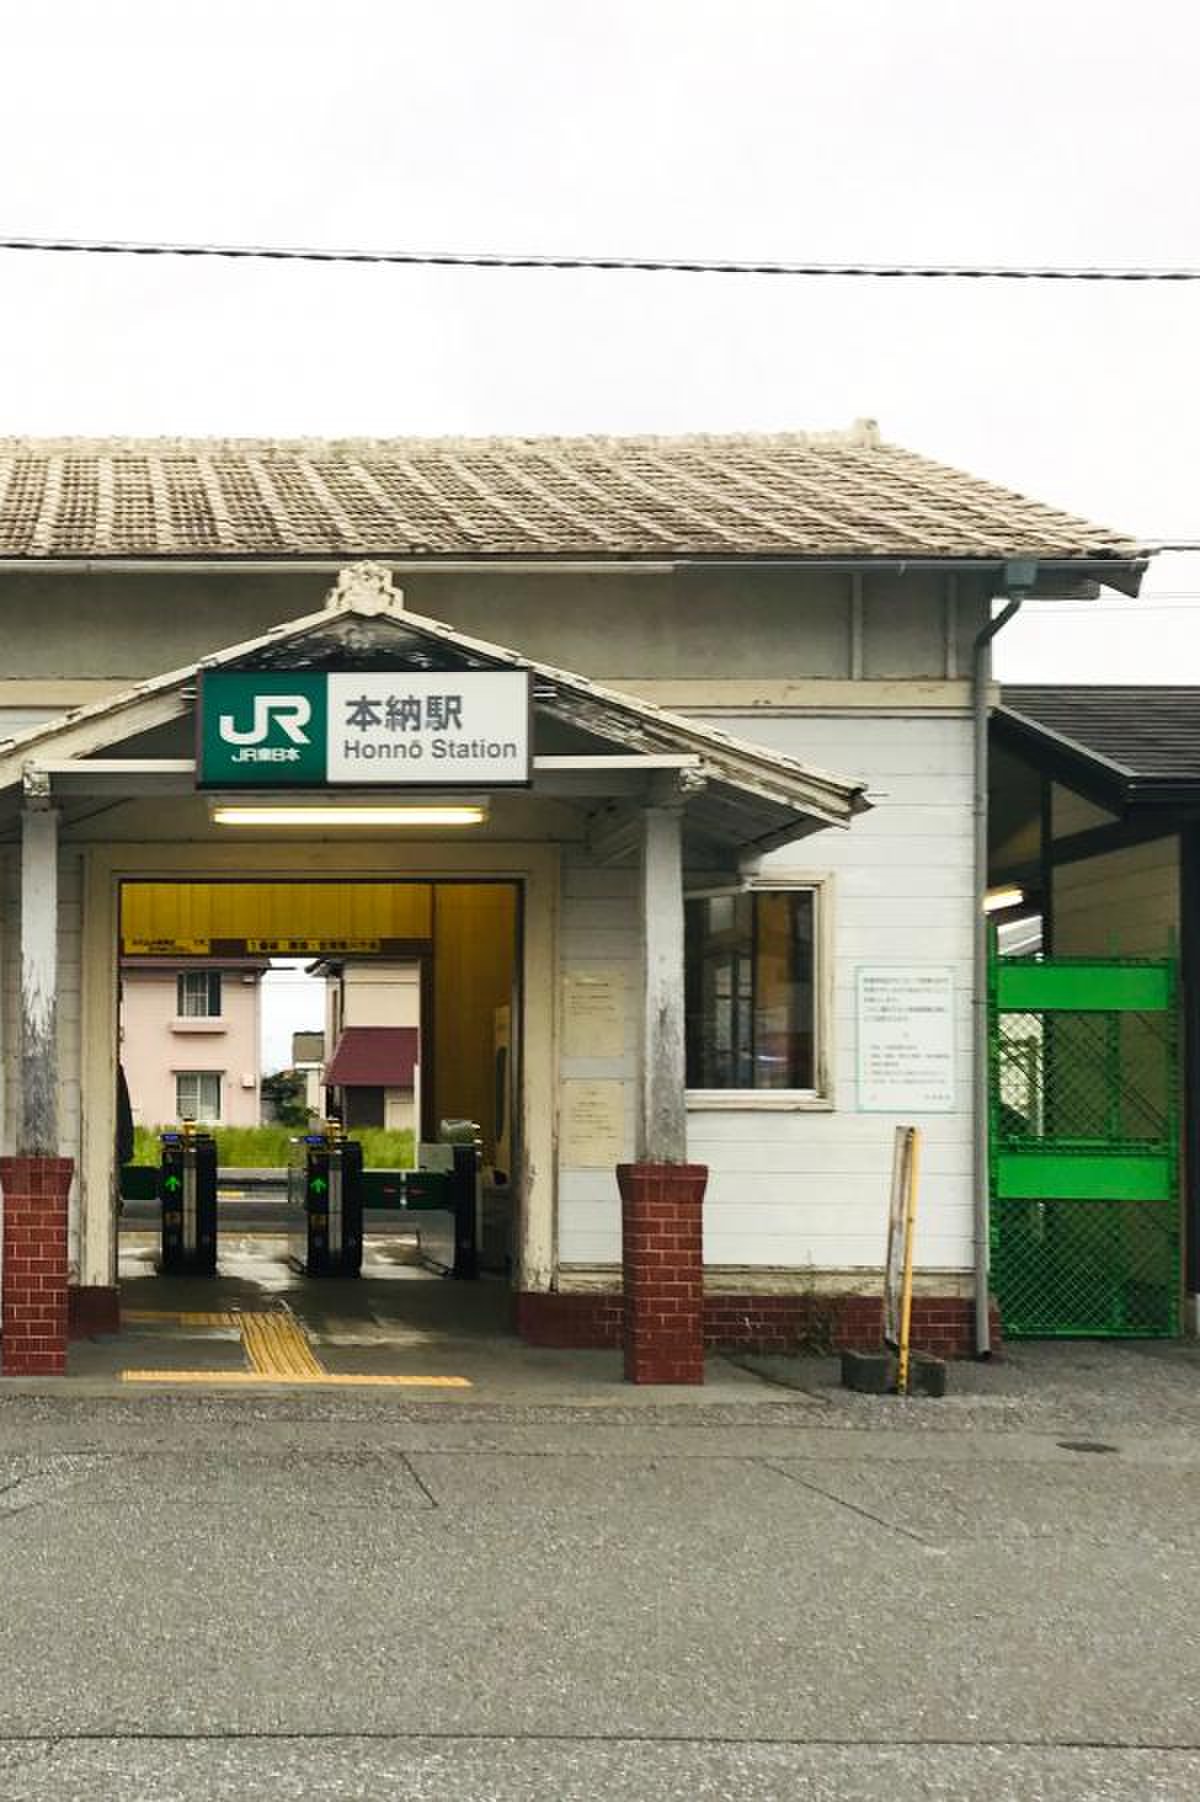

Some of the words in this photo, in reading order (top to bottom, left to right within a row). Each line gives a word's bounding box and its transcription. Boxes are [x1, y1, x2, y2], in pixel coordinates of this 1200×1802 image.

[219, 695, 311, 744] JR
[345, 695, 462, 732] 本納駅
[431, 738, 517, 759] Station
